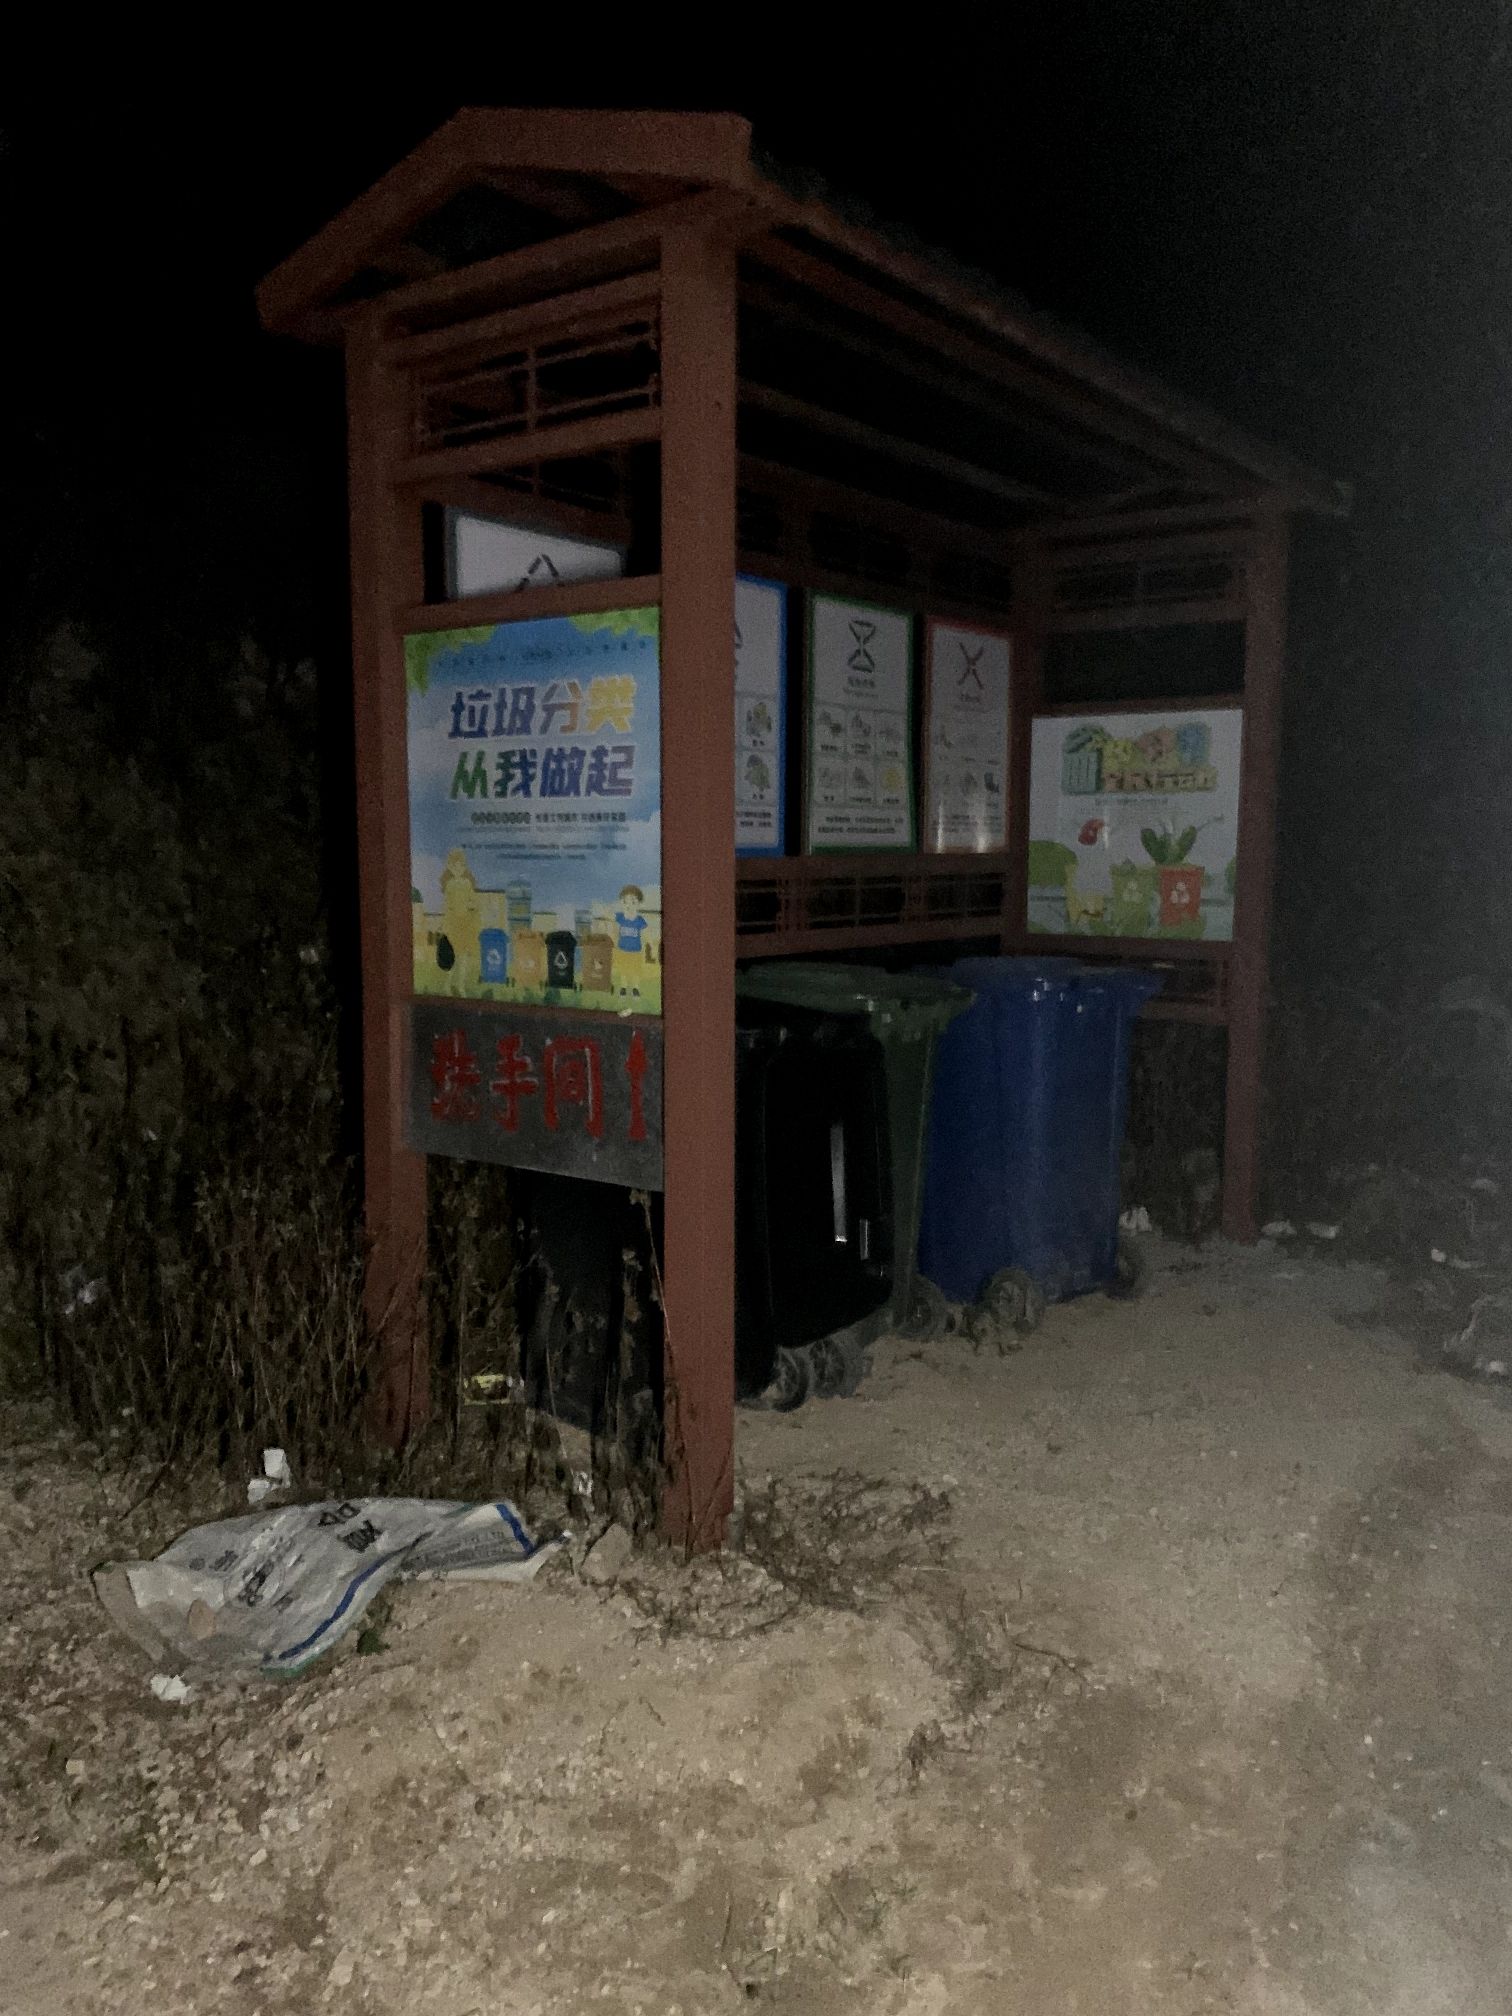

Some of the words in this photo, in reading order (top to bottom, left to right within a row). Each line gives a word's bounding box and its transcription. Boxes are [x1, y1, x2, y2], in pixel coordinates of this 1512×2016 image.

[448, 675, 637, 739] 垃圾分类
[450, 744, 637, 799] 从我做起
